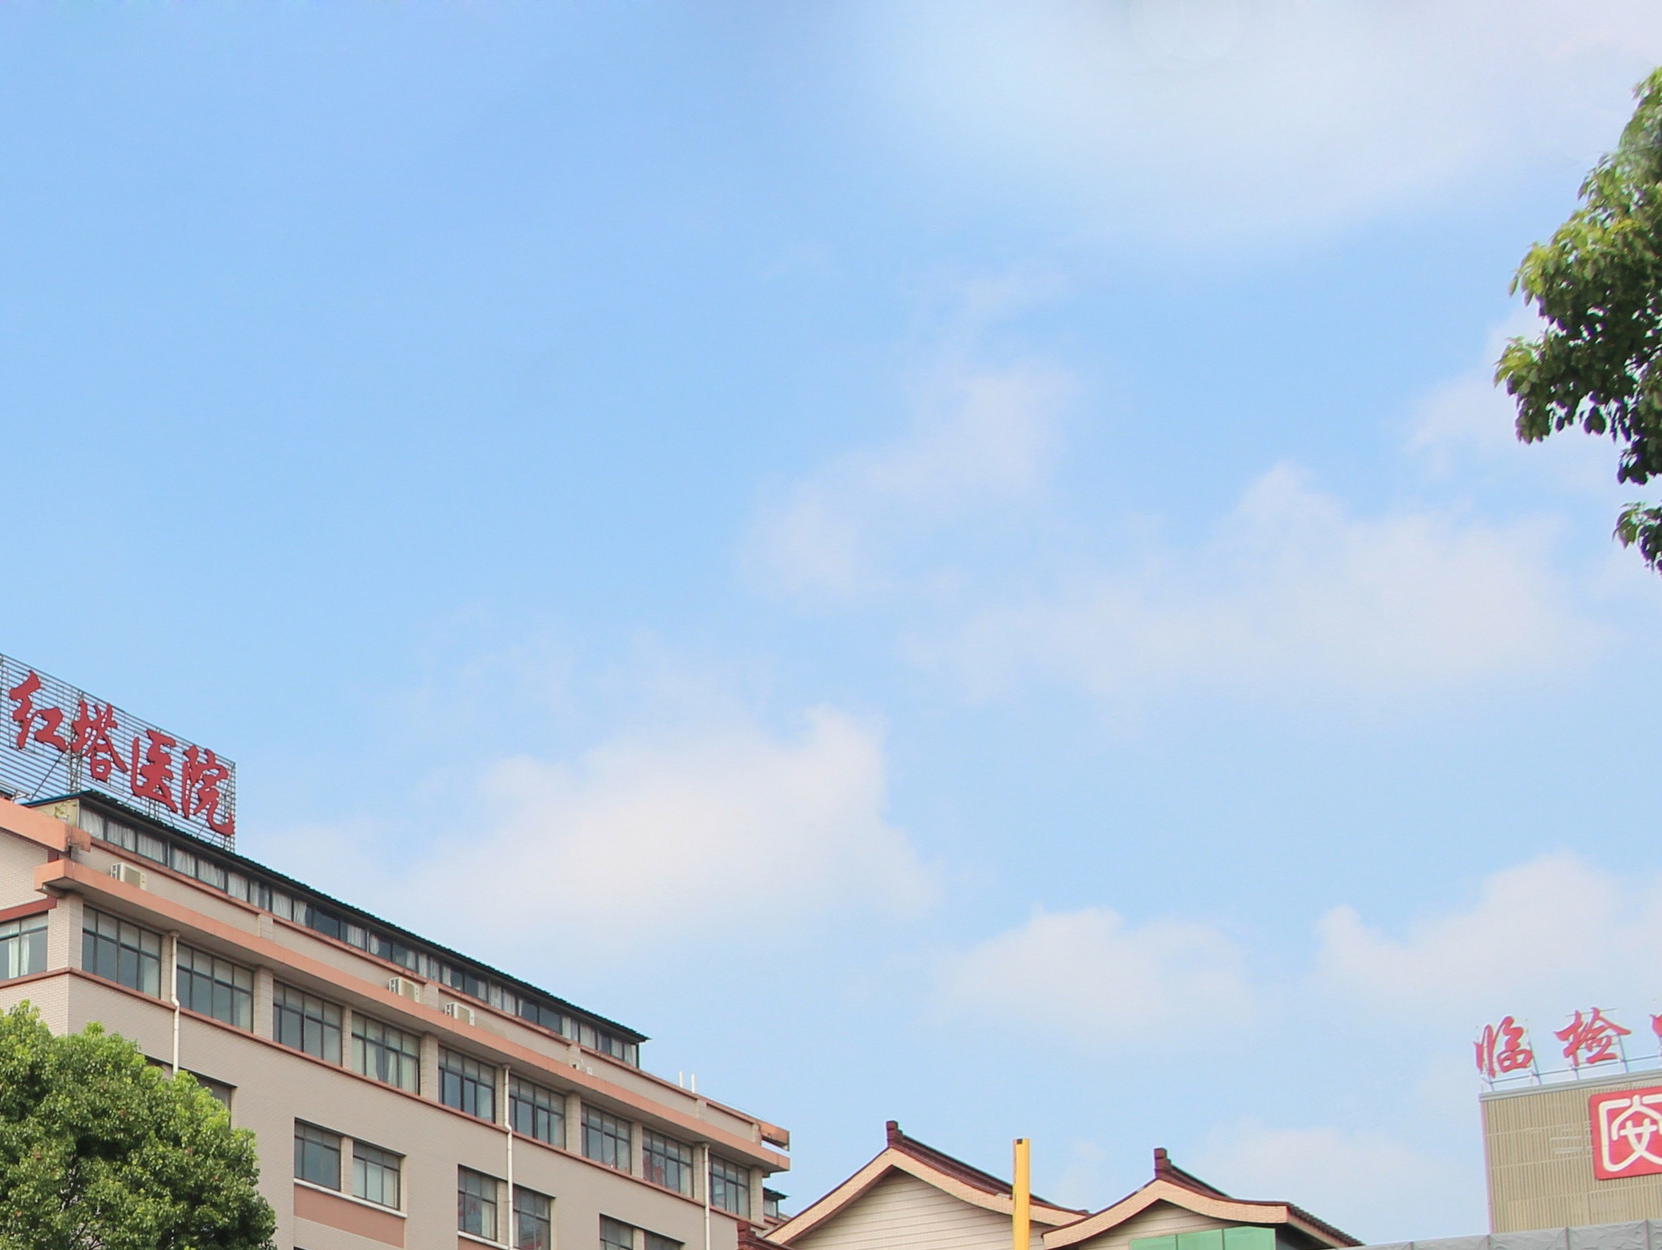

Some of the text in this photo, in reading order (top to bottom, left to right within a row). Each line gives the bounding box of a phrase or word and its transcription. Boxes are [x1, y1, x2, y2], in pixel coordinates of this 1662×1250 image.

[9, 670, 234, 836] 红塔医院
[1473, 1006, 1662, 1078] 临检
